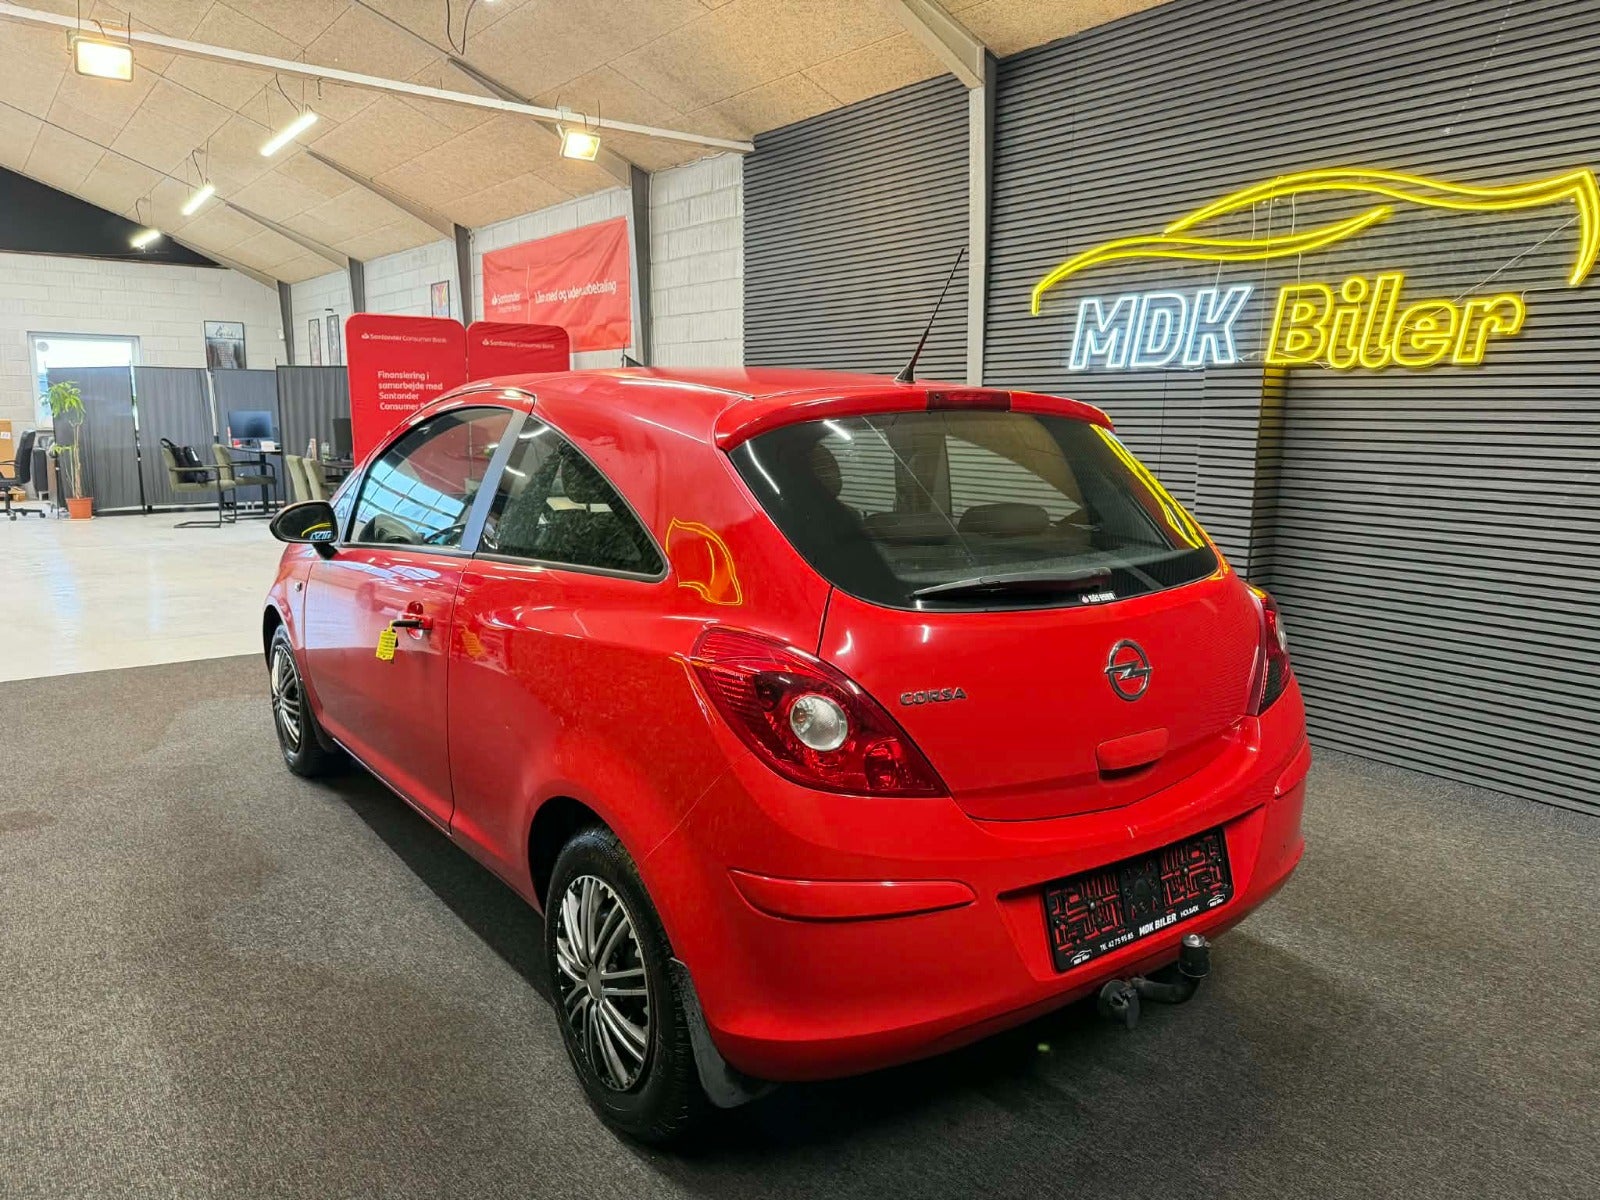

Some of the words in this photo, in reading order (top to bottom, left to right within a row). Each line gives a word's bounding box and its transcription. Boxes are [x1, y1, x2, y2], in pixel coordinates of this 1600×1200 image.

[558, 290, 567, 304] og
[1069, 285, 1254, 370] MDK
[1265, 272, 1525, 370] Biler
[369, 333, 401, 341] Santander
[378, 370, 426, 381] Finansiering
[378, 381, 425, 391] samarbejde
[425, 382, 443, 390] med
[378, 391, 419, 400] Santander
[380, 402, 419, 411] Consumer
[900, 686, 967, 706] CORSA
[1139, 922, 1154, 937] MDK
[1155, 913, 1177, 929] BILER
